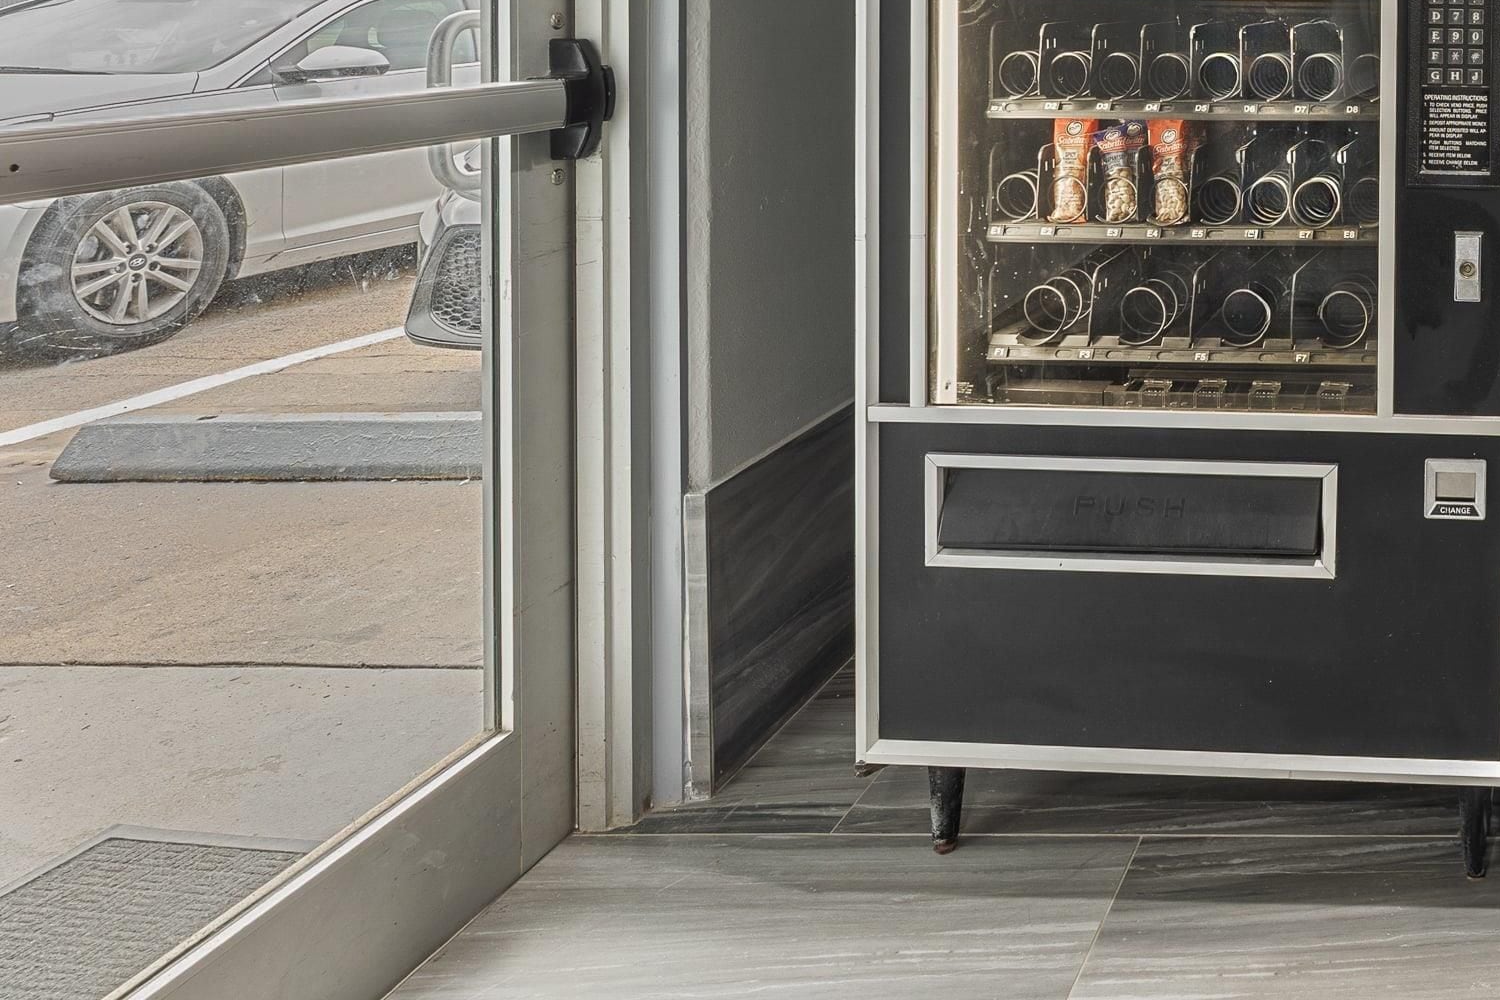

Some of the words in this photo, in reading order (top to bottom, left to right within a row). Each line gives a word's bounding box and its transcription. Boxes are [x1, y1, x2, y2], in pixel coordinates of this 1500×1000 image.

[1432, 11, 1441, 20] D
[1452, 12, 1459, 21] 7
[1472, 12, 1480, 21] 8
[1432, 31, 1440, 40] E
[1452, 32, 1459, 41] 9
[1472, 32, 1479, 41] 0
[1432, 51, 1440, 60] F
[1431, 71, 1440, 80] G
[1451, 71, 1460, 81] H
[1472, 72, 1479, 81] J
[1044, 102, 1057, 110] D2
[1096, 102, 1109, 110] D3
[1243, 105, 1255, 113] D6
[1294, 105, 1307, 113] D7
[1346, 105, 1358, 113] D8
[990, 227, 1001, 235] E1
[1040, 227, 1052, 235] E2
[1191, 230, 1204, 238] E5
[1299, 230, 1311, 238] E7
[1344, 230, 1355, 238] E8
[994, 348, 1004, 356] F1
[1194, 353, 1206, 361] F5
[1295, 354, 1307, 362] F7
[1072, 495, 1186, 519] PUSH
[1440, 506, 1471, 514] CHANGE
